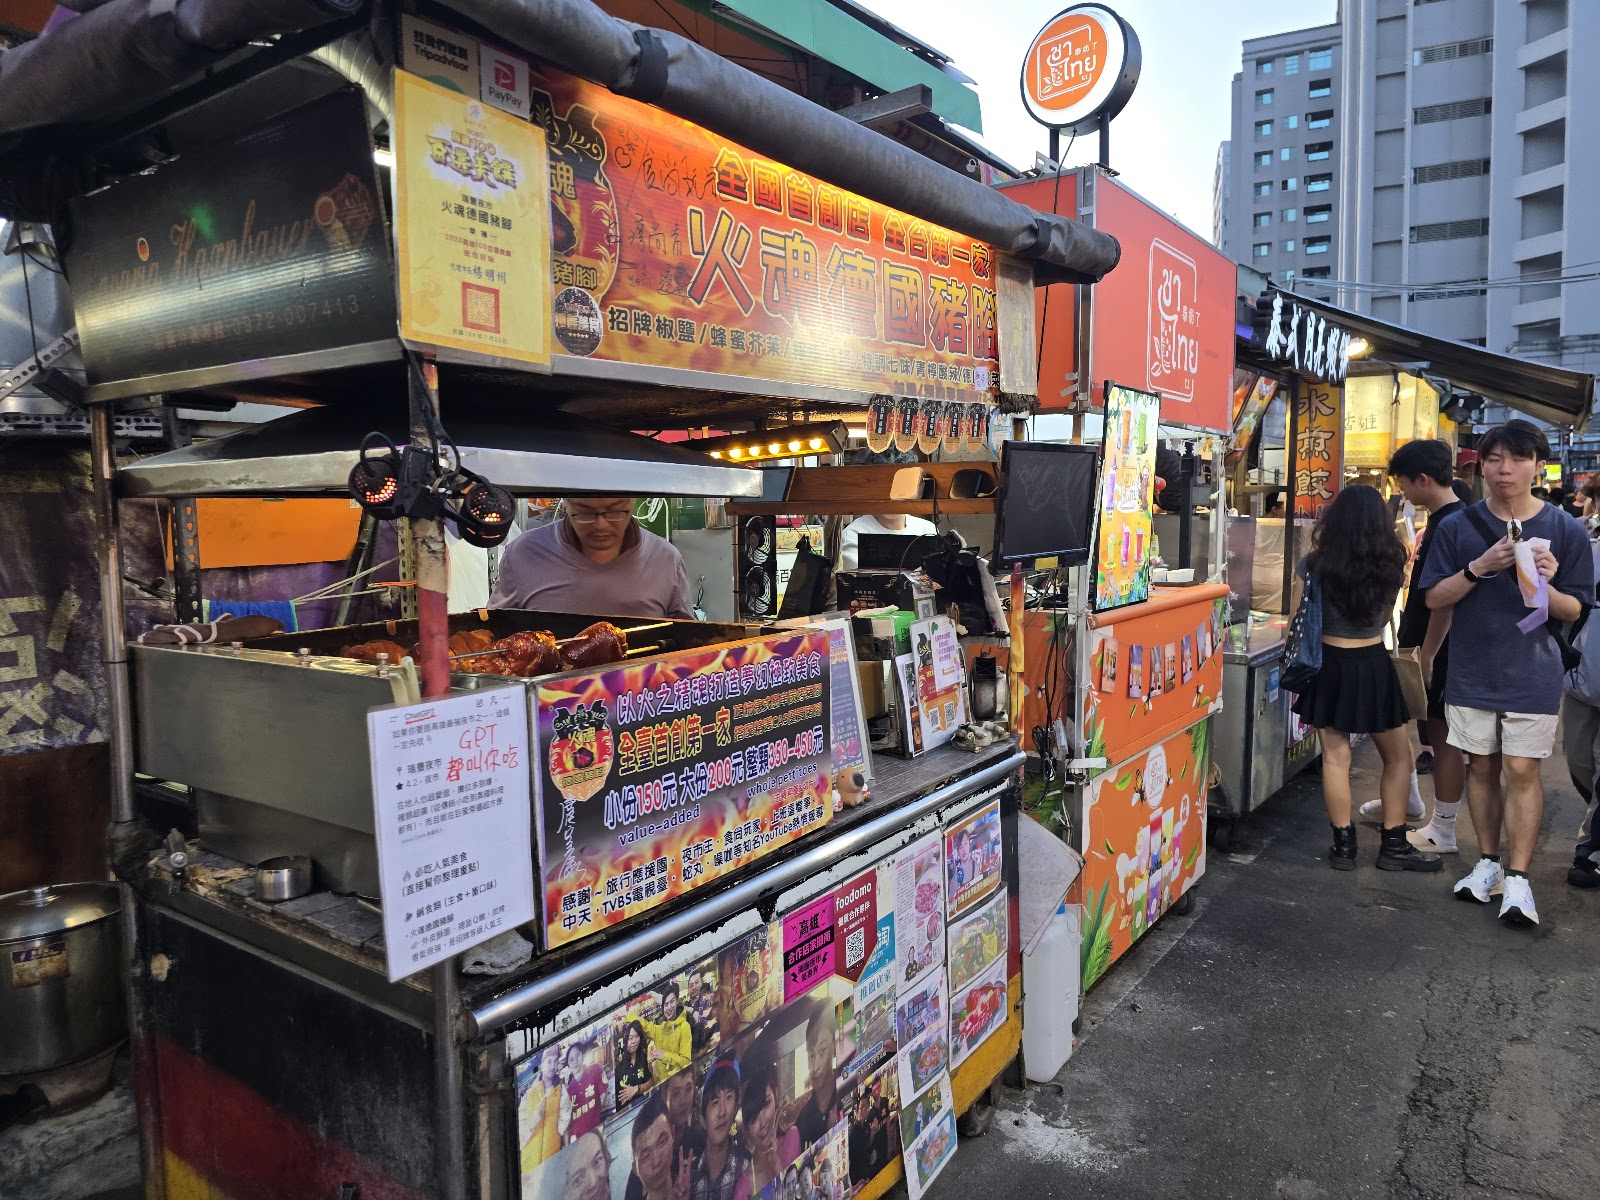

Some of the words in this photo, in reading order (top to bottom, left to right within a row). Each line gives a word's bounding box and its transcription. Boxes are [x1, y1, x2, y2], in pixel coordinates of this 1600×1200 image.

[413, 48, 470, 73] Tripadvisor
[488, 86, 523, 108] PayPay
[441, 199, 513, 231] 火魂德國豬腳
[713, 146, 871, 243] 全國首創店
[882, 210, 991, 281] 全台第一家
[1295, 388, 1336, 500] 水煎餃
[459, 723, 498, 750] GPT
[445, 744, 519, 782] 都叫你吃
[604, 771, 678, 830] 小份150元
[679, 751, 745, 805] 大份200元
[747, 779, 776, 798] whole
[619, 804, 700, 847] value-added
[835, 882, 873, 912] foodomo
[799, 912, 821, 939] 高雄
